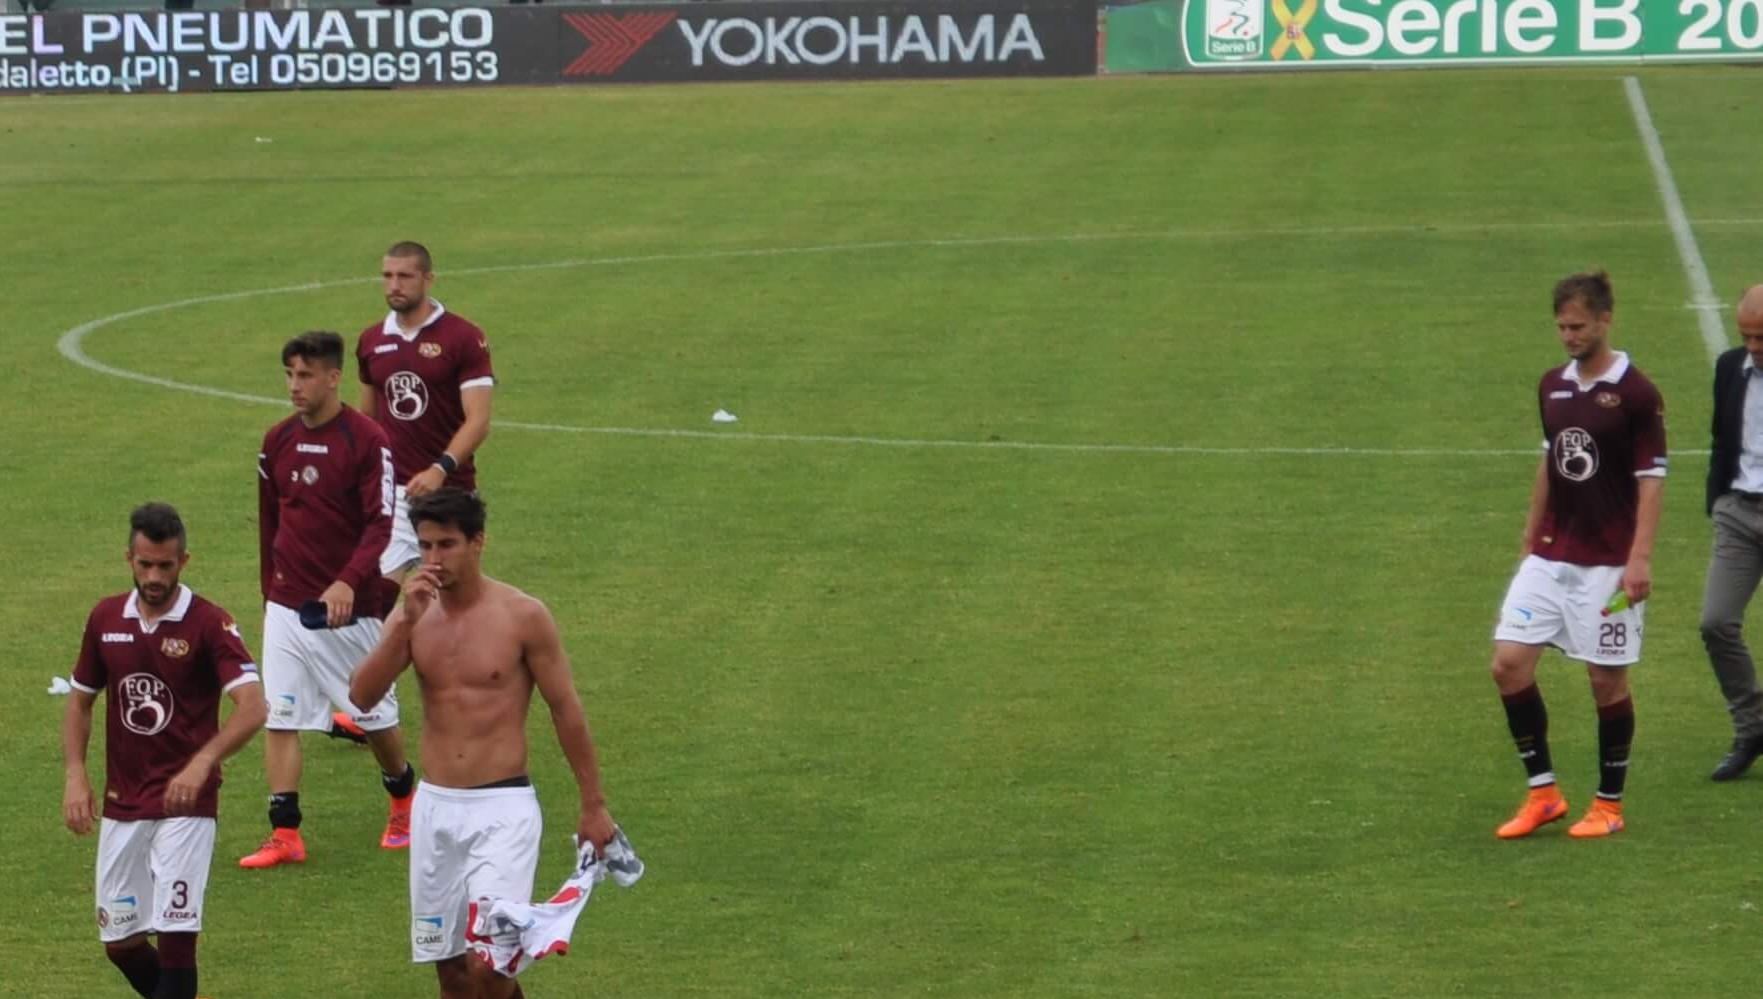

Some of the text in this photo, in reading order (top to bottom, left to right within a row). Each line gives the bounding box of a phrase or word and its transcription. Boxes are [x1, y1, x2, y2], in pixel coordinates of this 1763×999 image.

[82, 8, 494, 53] PNEUMATICO
[677, 14, 1044, 65] YOKOHAMA
[1323, 0, 1558, 55] Serie
[1579, 0, 1642, 51] B
[1212, 40, 1242, 53] Serie
[121, 55, 179, 92] (PI)
[207, 54, 258, 84] Tel
[270, 51, 498, 82] 050969153
[1599, 622, 1628, 648] 28
[171, 880, 189, 910] 3
[162, 911, 198, 919] LEGEA
[416, 934, 444, 946] CAME
